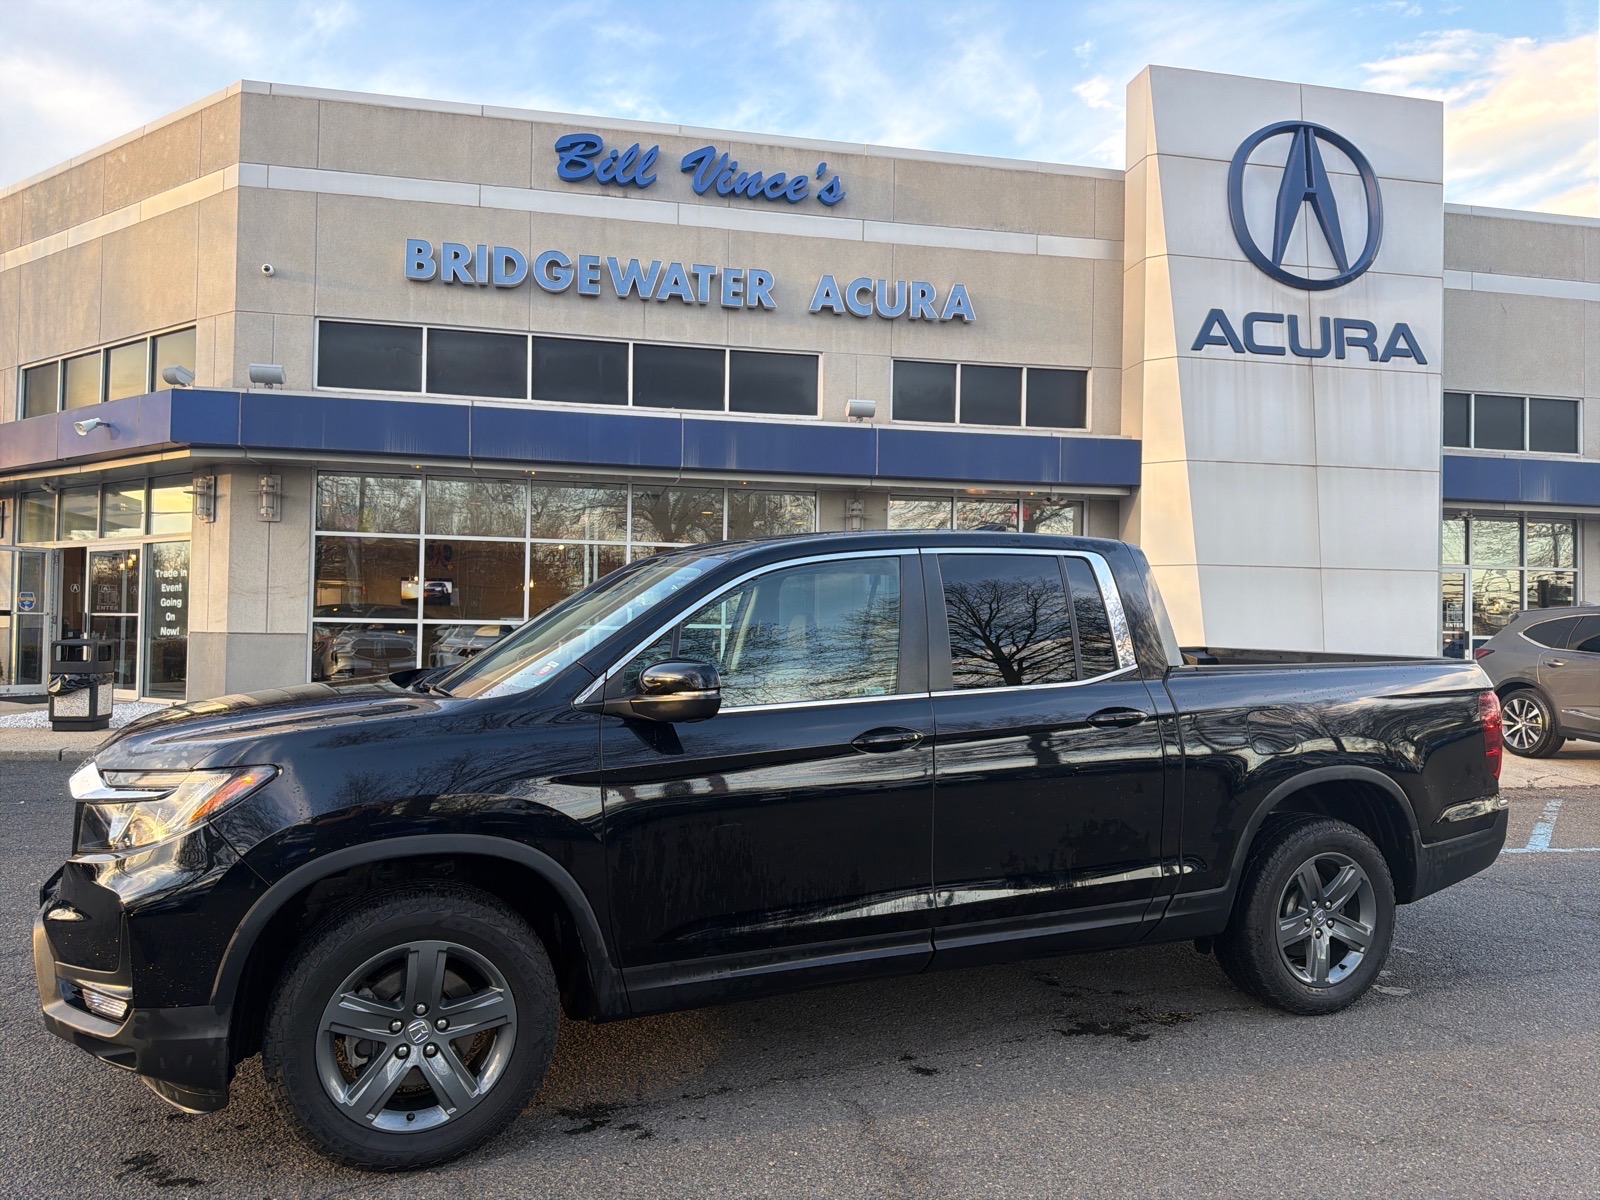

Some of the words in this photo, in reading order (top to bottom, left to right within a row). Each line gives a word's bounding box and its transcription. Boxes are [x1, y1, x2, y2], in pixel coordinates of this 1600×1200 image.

[554, 132, 660, 189] Bill
[680, 145, 847, 207] Vince's
[404, 237, 778, 310] BRIDGEWATER
[808, 274, 977, 323] ACURA
[1190, 307, 1428, 365] ACURA
[155, 569, 178, 578] Trade
[161, 583, 182, 592] Event
[160, 598, 182, 608] Going
[165, 612, 176, 622] On
[160, 626, 180, 636] Now!
